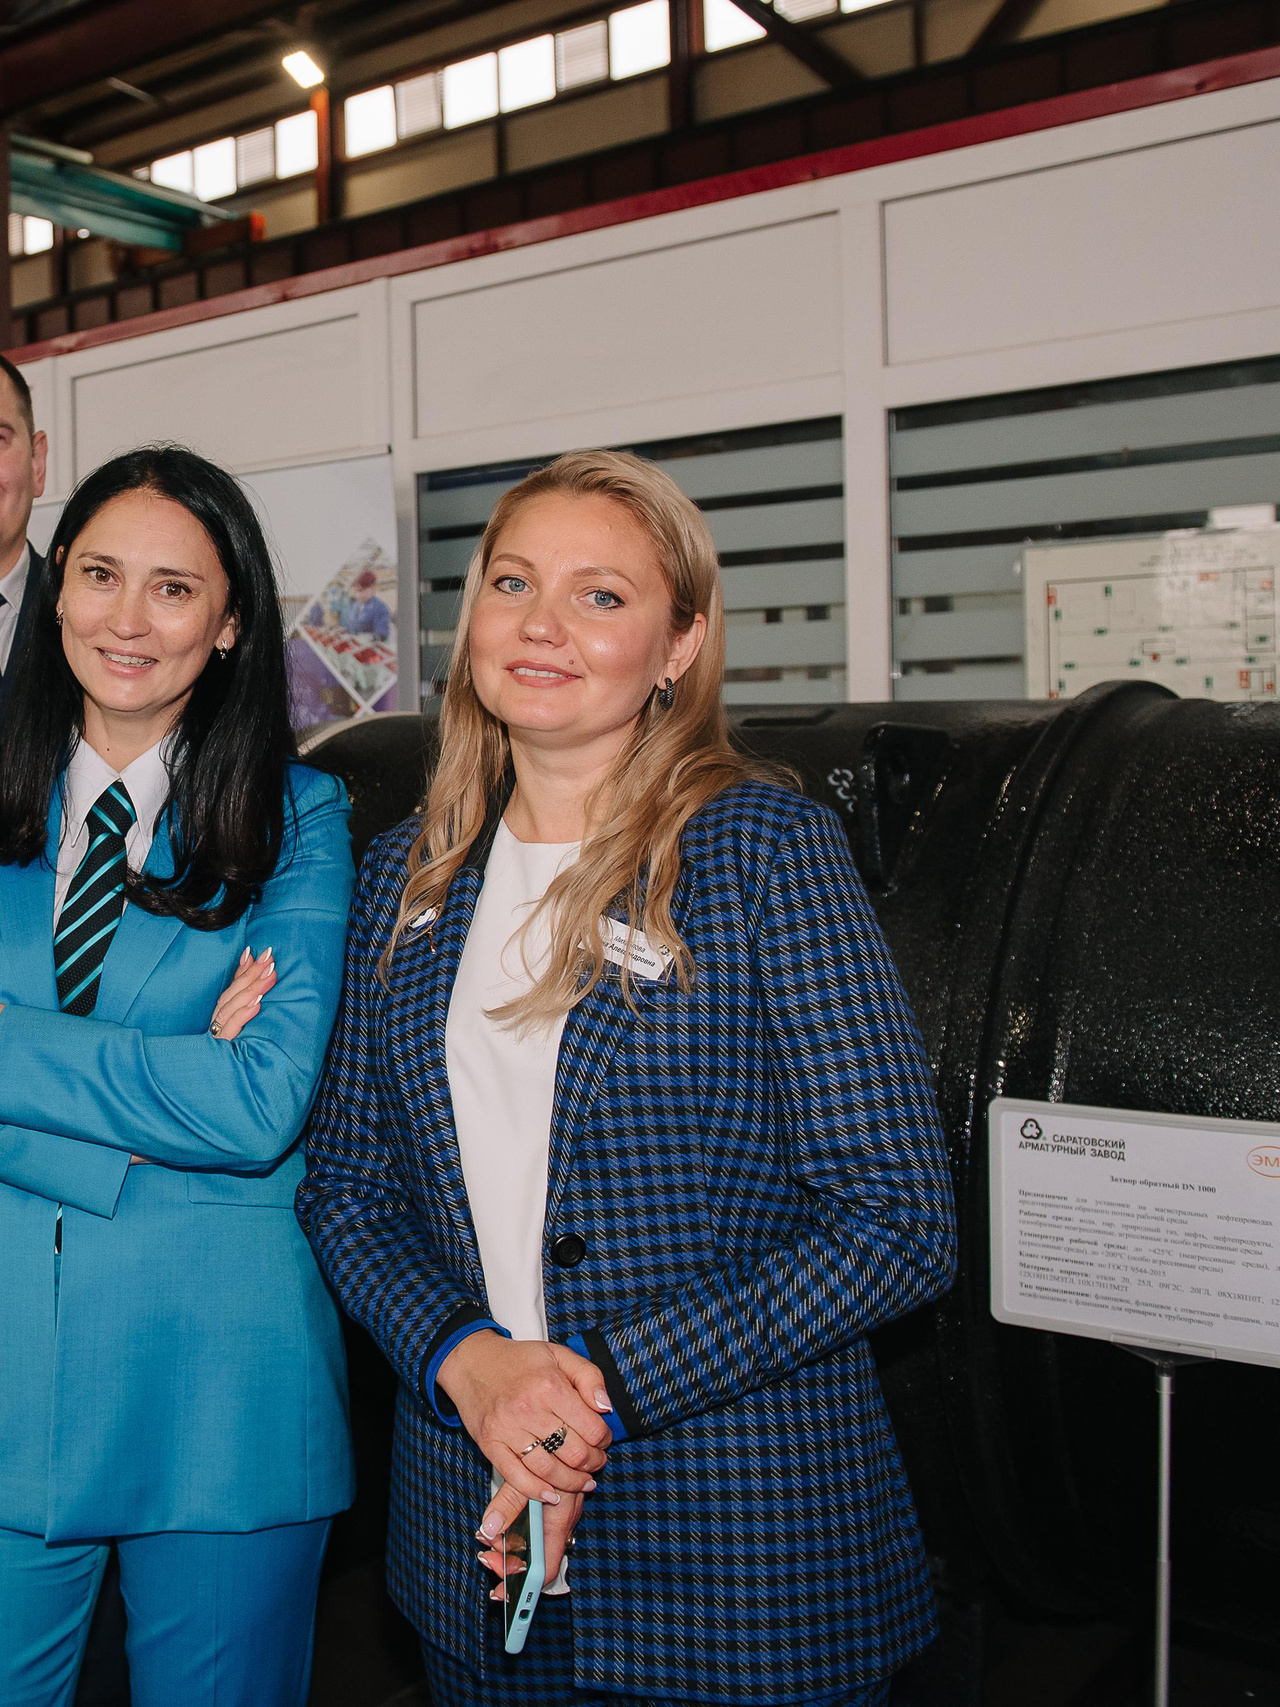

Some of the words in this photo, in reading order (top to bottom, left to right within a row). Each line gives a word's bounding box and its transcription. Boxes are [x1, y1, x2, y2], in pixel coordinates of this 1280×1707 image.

[614, 936, 646, 953] Михлова
[609, 943, 656, 967] Алексндровна
[1053, 1134, 1126, 1149] САРАТОВСКИЙ
[1019, 1141, 1086, 1156] АРМАТУРНЫЙ
[1091, 1149, 1125, 1161] ЗАВОД
[1252, 1155, 1280, 1167] ЭМ
[1110, 1175, 1137, 1186] Затвор
[1139, 1179, 1180, 1189] обратный
[1155, 1207, 1208, 1218] магистральных
[1217, 1215, 1273, 1226] нефтепроводах
[1213, 1236, 1273, 1248] нефтепродукты,
[1108, 1263, 1128, 1272] ГОСТ
